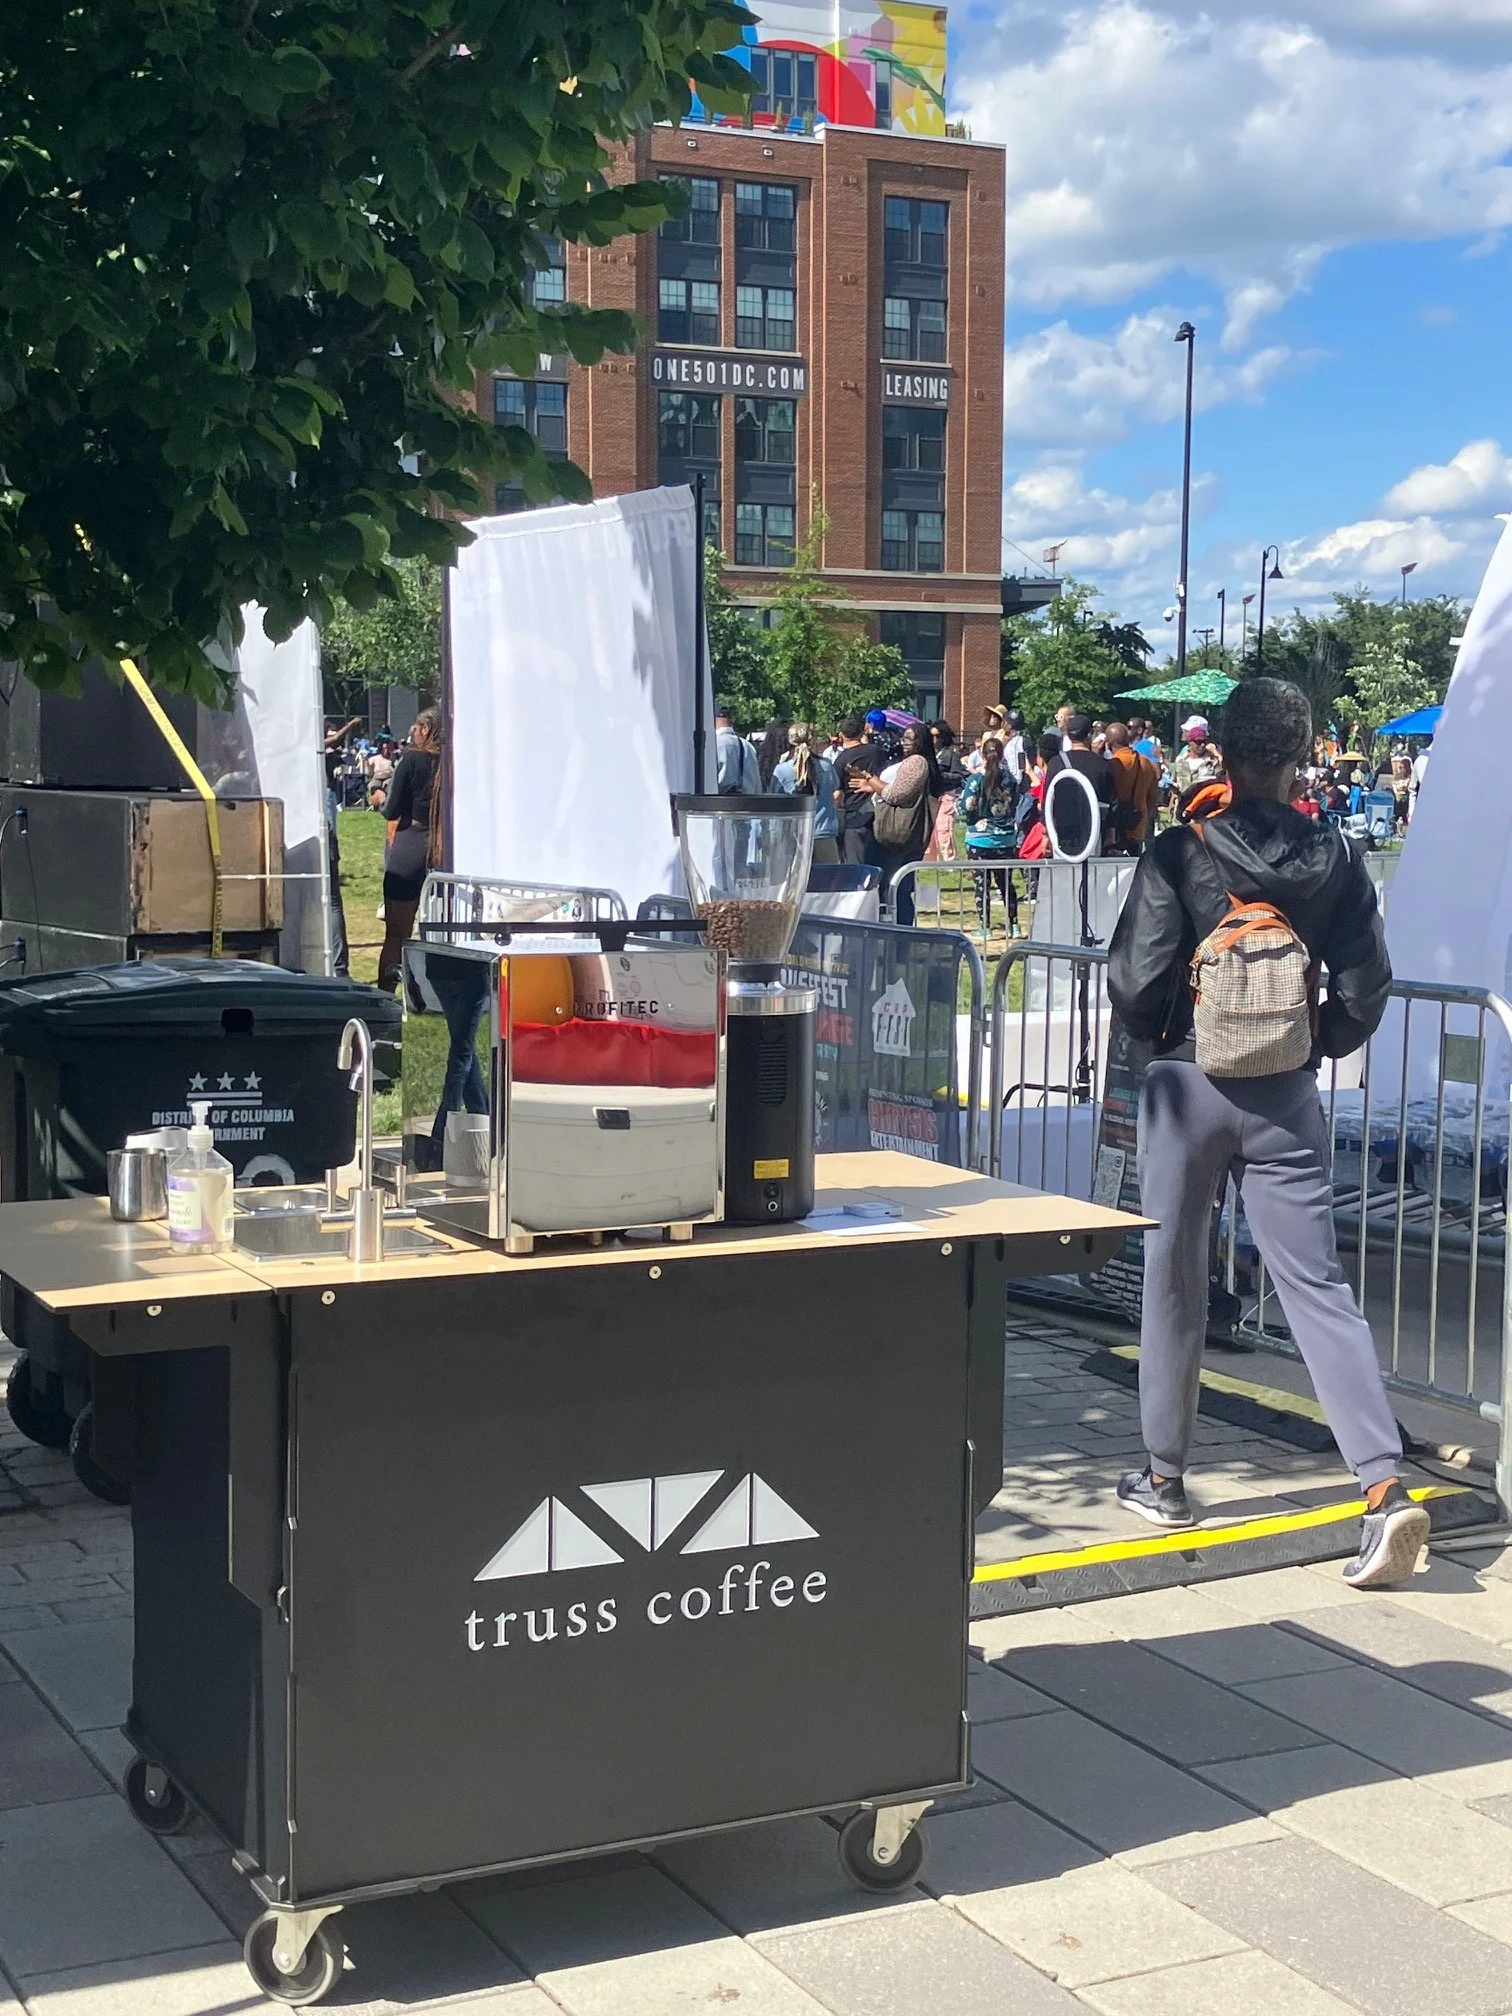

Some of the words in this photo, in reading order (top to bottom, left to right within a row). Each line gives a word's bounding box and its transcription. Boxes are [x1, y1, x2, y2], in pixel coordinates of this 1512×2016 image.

[653, 357, 804, 391] ONE501DC.COM
[886, 374, 948, 400] LEASING
[572, 1000, 659, 1017] PROFITEC
[152, 1111, 194, 1126] DISTRI
[211, 1110, 229, 1124] OF
[231, 1109, 295, 1123] COLUMBIA
[464, 1598, 618, 1652] truss
[646, 1560, 828, 1625] coffee
